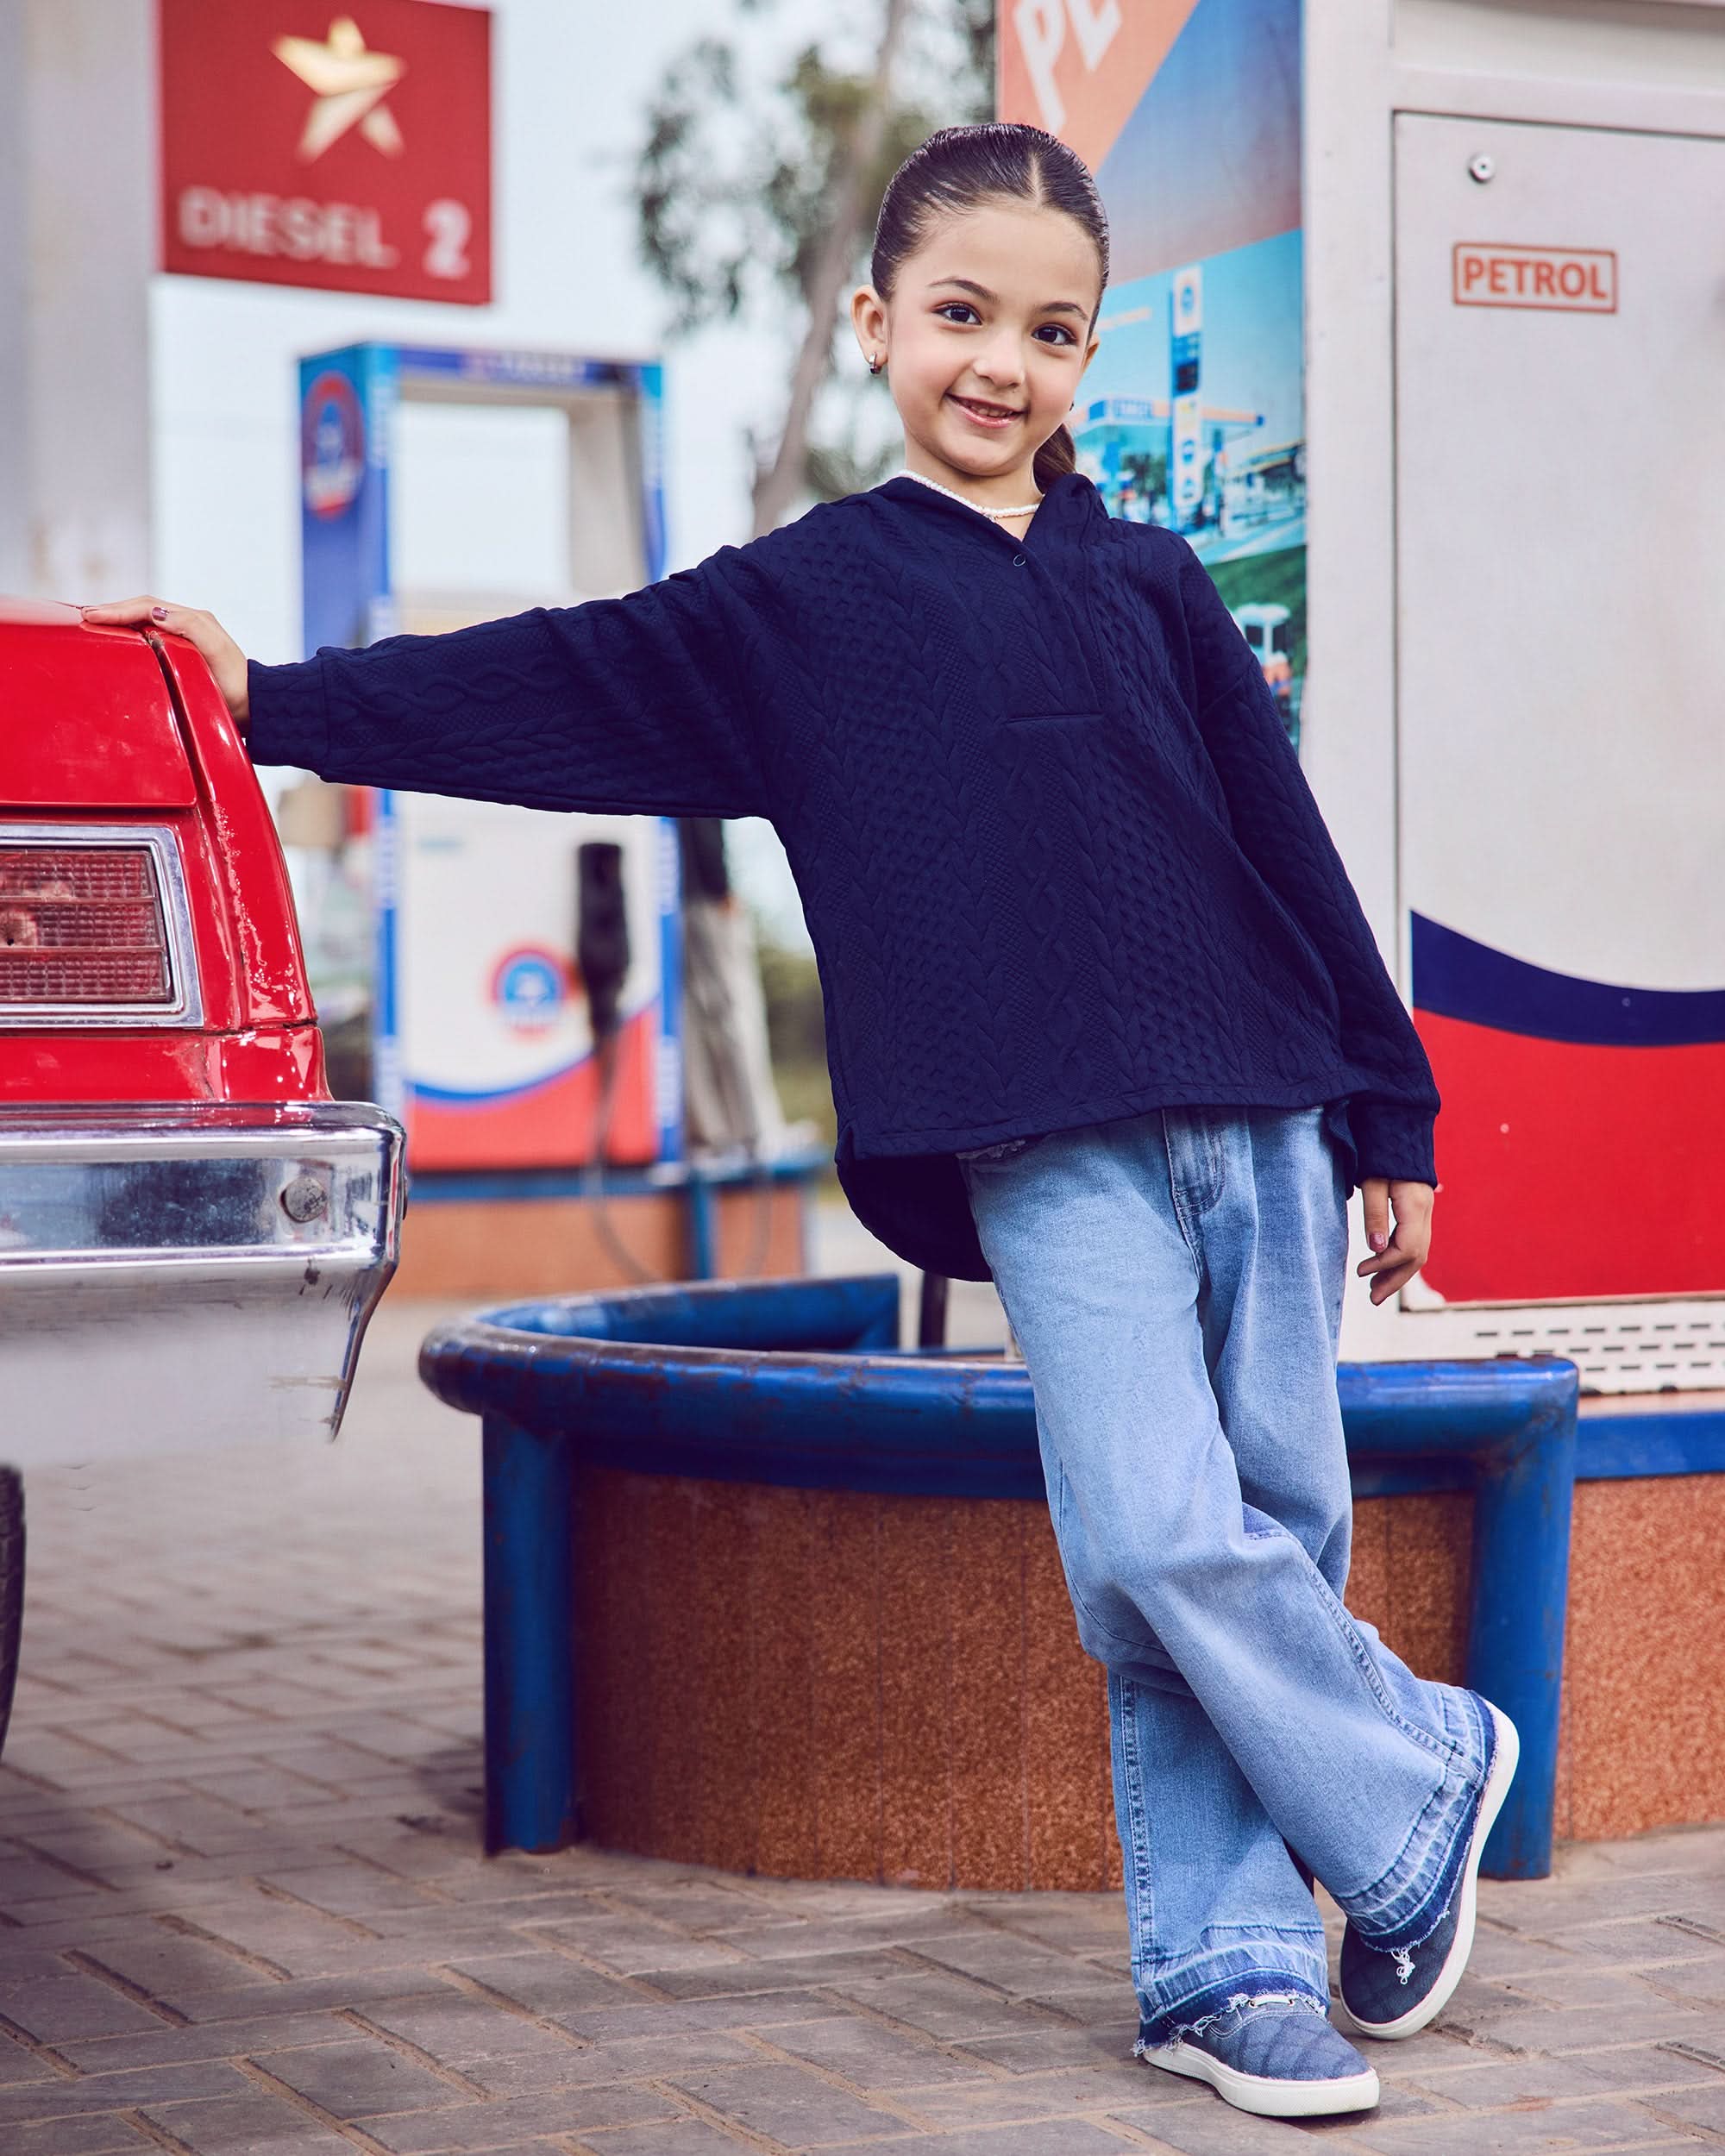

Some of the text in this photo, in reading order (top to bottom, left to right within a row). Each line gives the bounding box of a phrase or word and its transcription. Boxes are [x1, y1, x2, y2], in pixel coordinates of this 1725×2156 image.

[179, 186, 471, 279] DIESEL 2
[1463, 255, 1608, 299] PETROL
